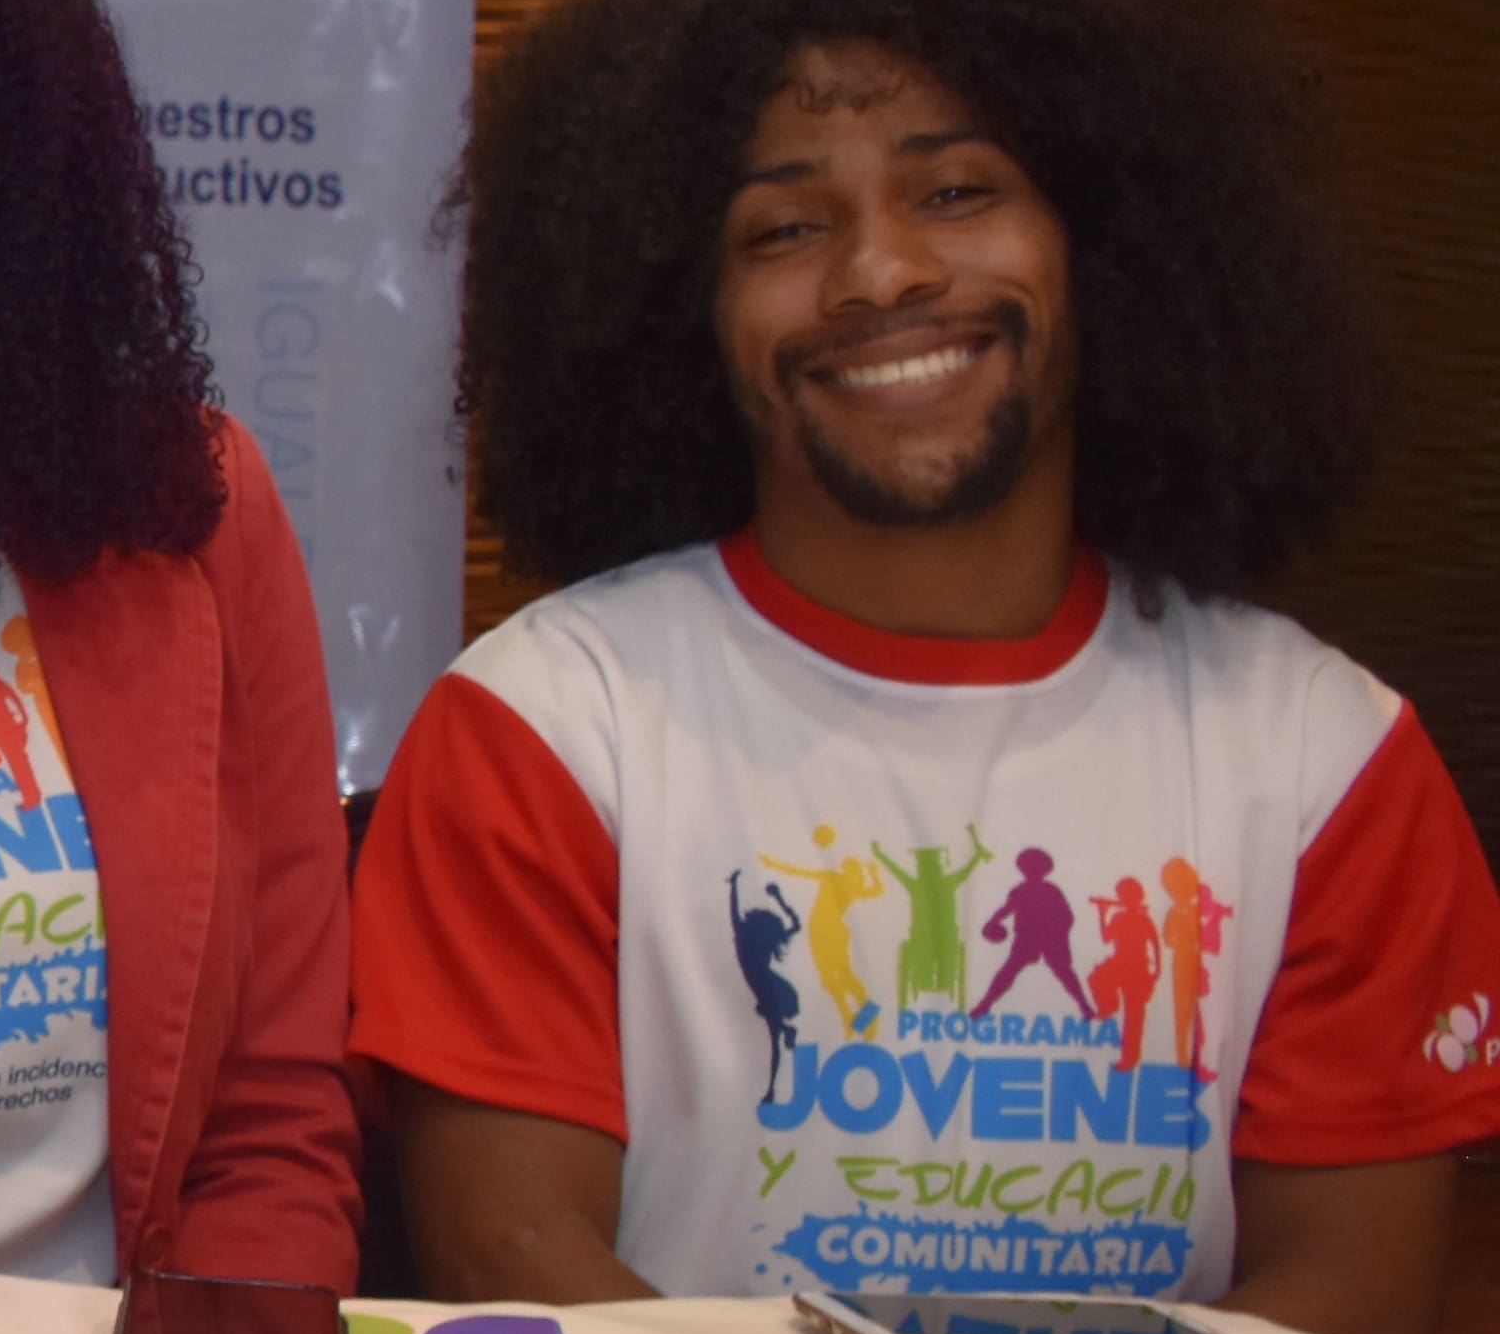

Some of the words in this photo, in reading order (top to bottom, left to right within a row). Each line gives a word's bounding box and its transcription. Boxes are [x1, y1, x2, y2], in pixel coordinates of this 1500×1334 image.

[145, 95, 316, 144] estros
[897, 1010, 1123, 1048] PROGRAMA
[8, 1057, 107, 1085] incidenc
[757, 1145, 797, 1199] Y
[816, 1224, 1175, 1278] COMUNITARIA
